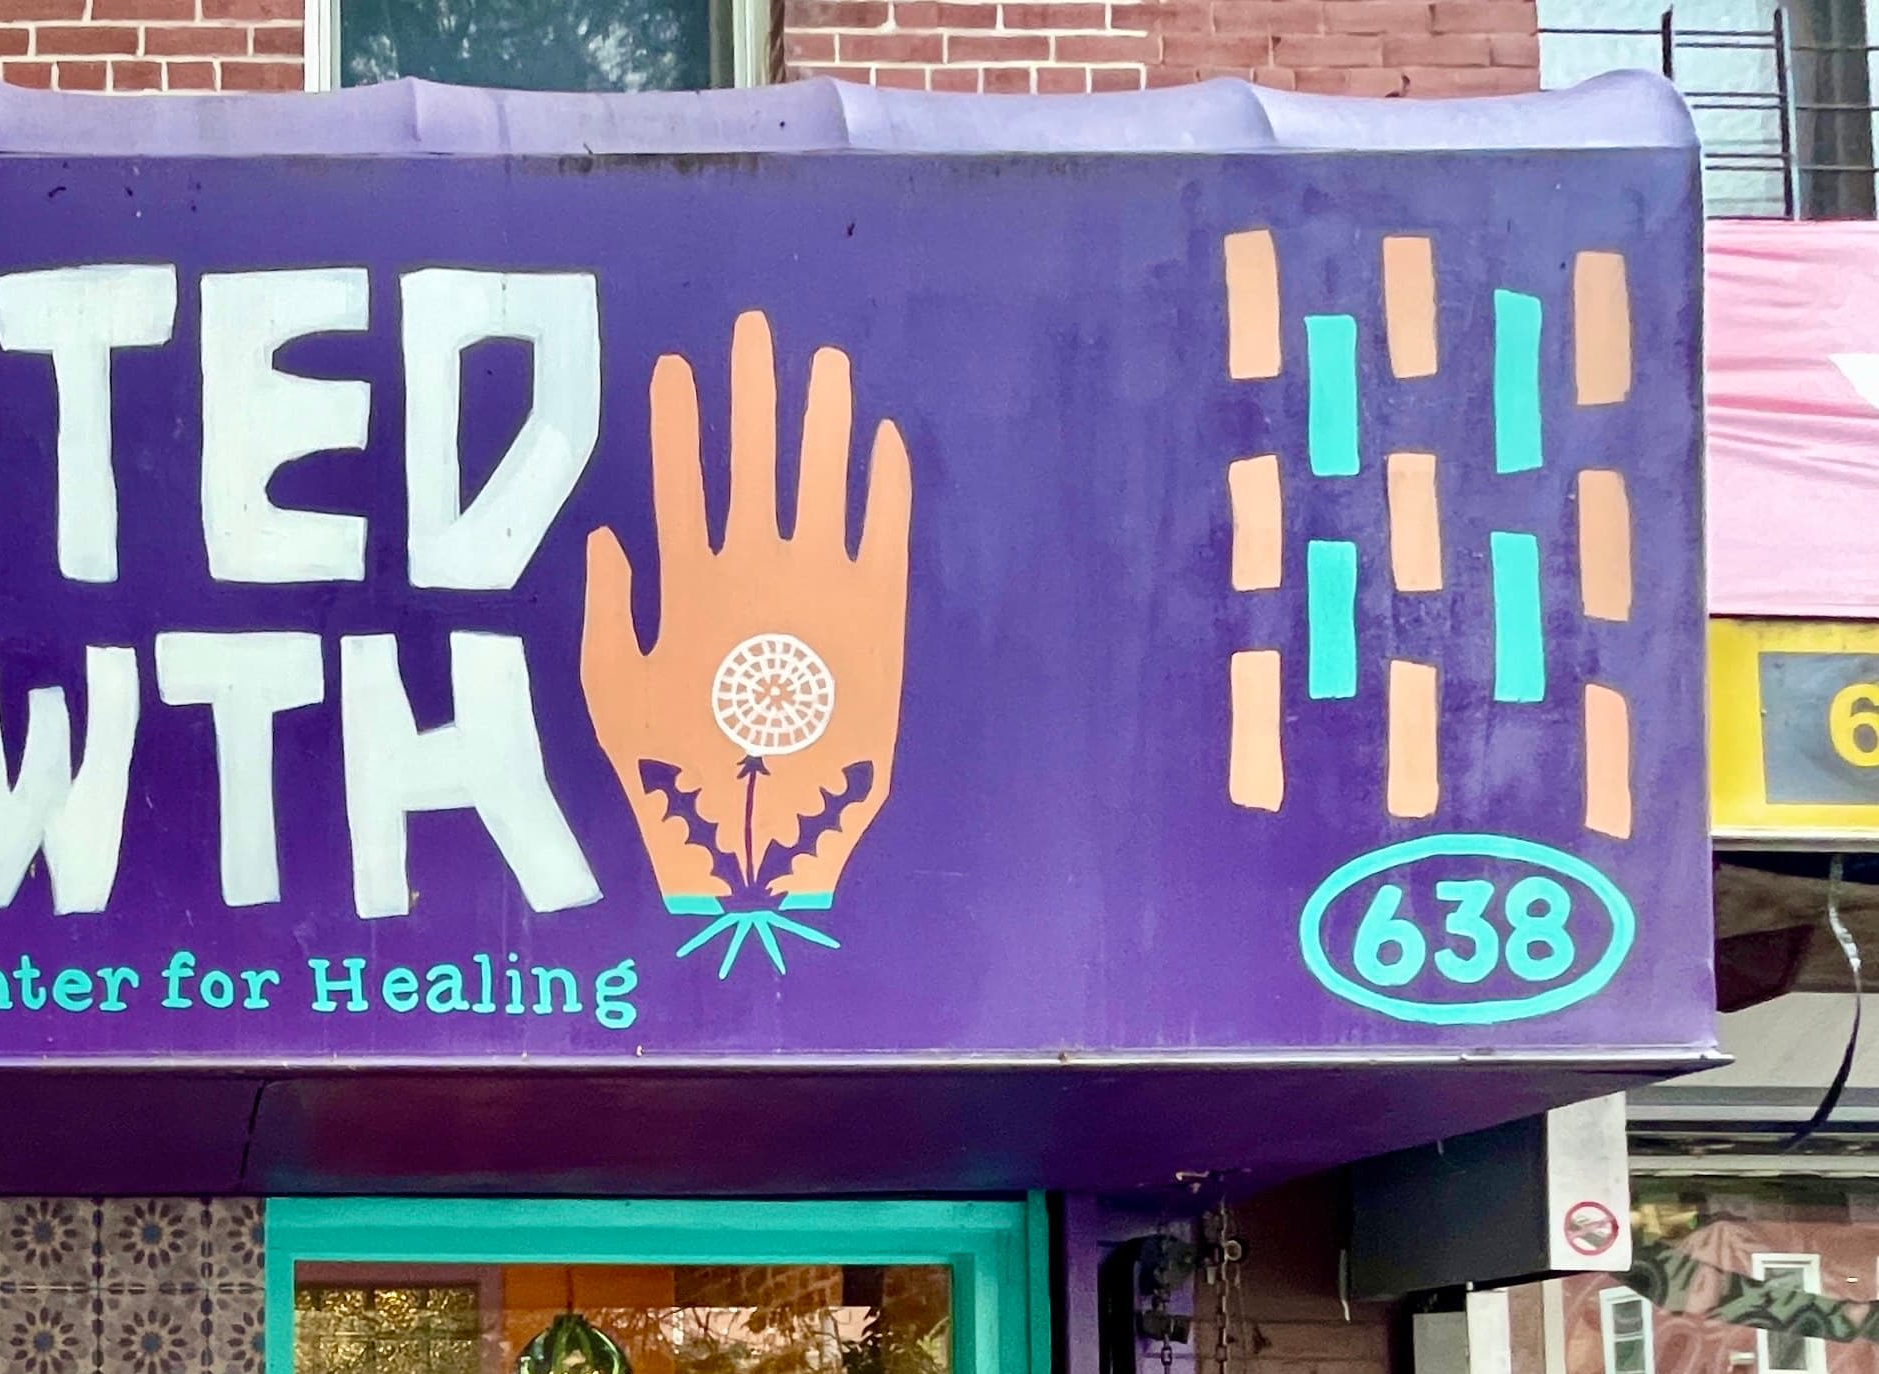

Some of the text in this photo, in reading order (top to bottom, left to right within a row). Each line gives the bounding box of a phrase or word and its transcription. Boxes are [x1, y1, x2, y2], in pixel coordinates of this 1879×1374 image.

[1353, 876, 1575, 986] 638
[163, 950, 280, 1010] for
[308, 951, 639, 1029] Healing
